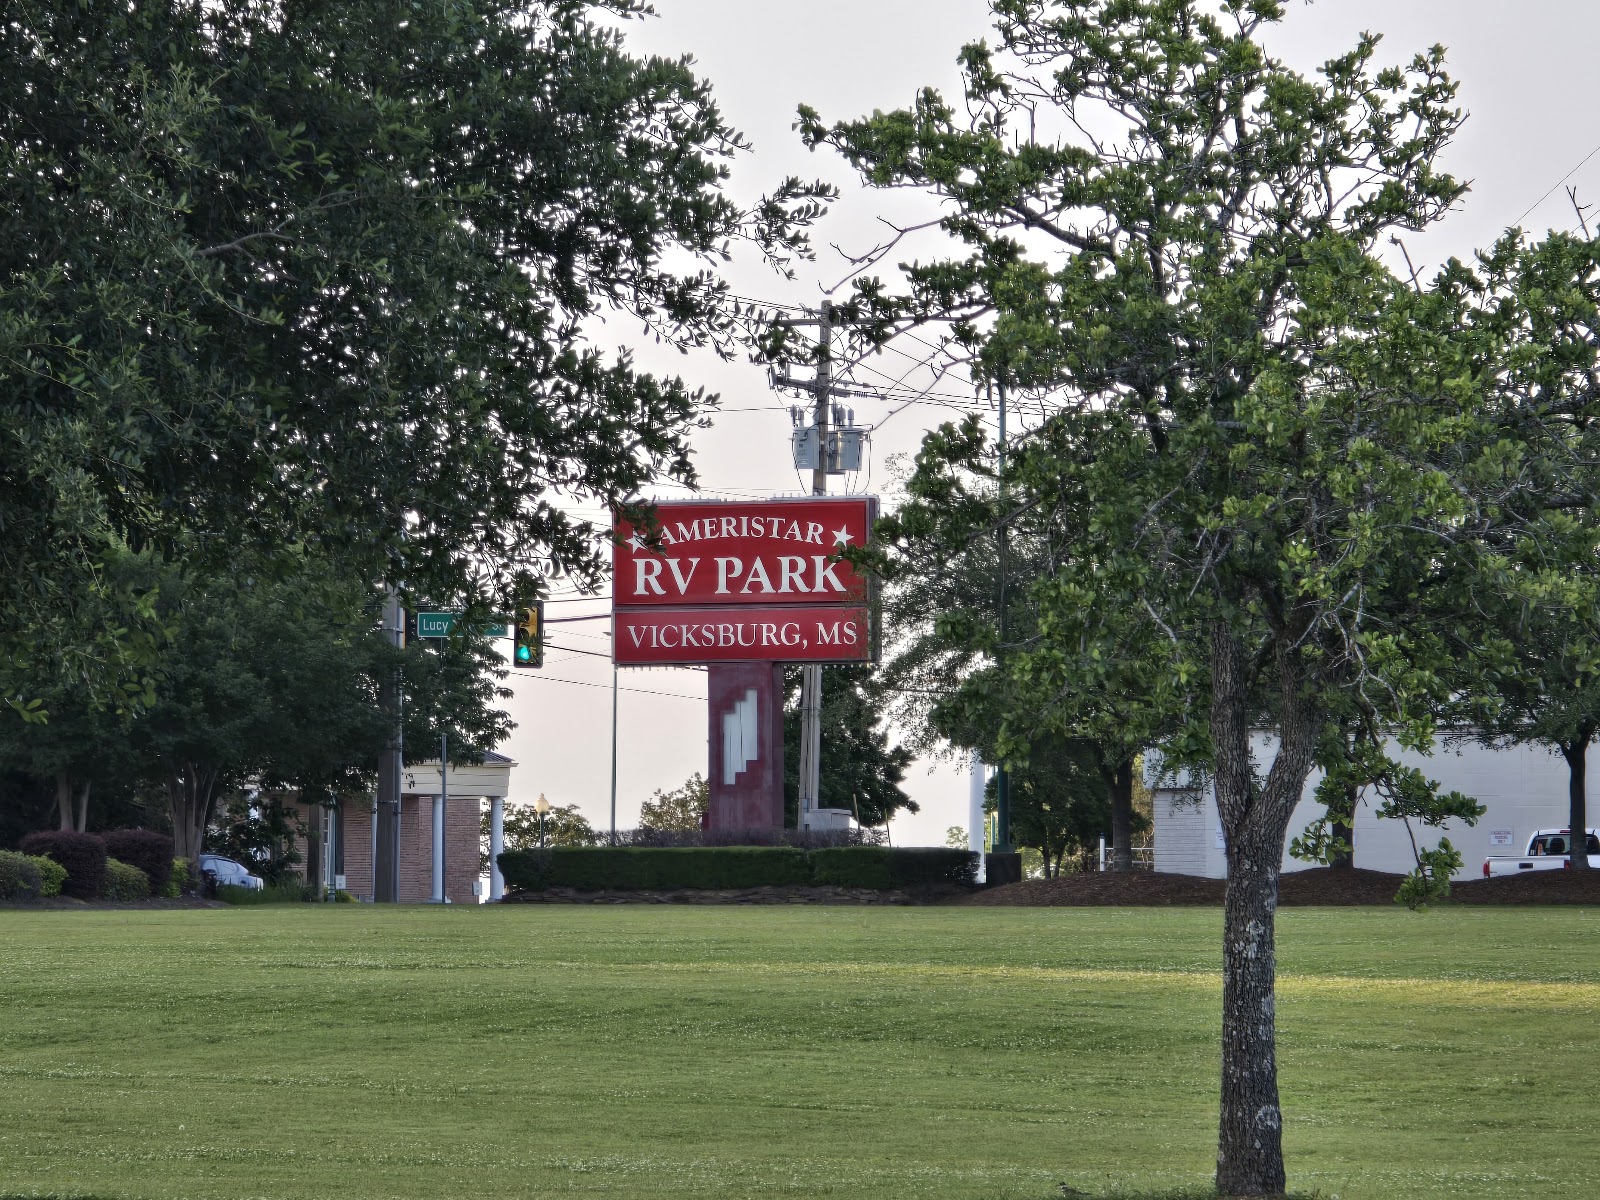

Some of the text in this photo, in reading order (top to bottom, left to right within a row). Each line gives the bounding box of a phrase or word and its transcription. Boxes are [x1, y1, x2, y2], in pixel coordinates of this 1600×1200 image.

[659, 516, 824, 546] AMERISTAR
[633, 555, 847, 595] RV PARK
[423, 619, 449, 633] Lucy
[627, 621, 857, 650] VICKSBURG, MS
